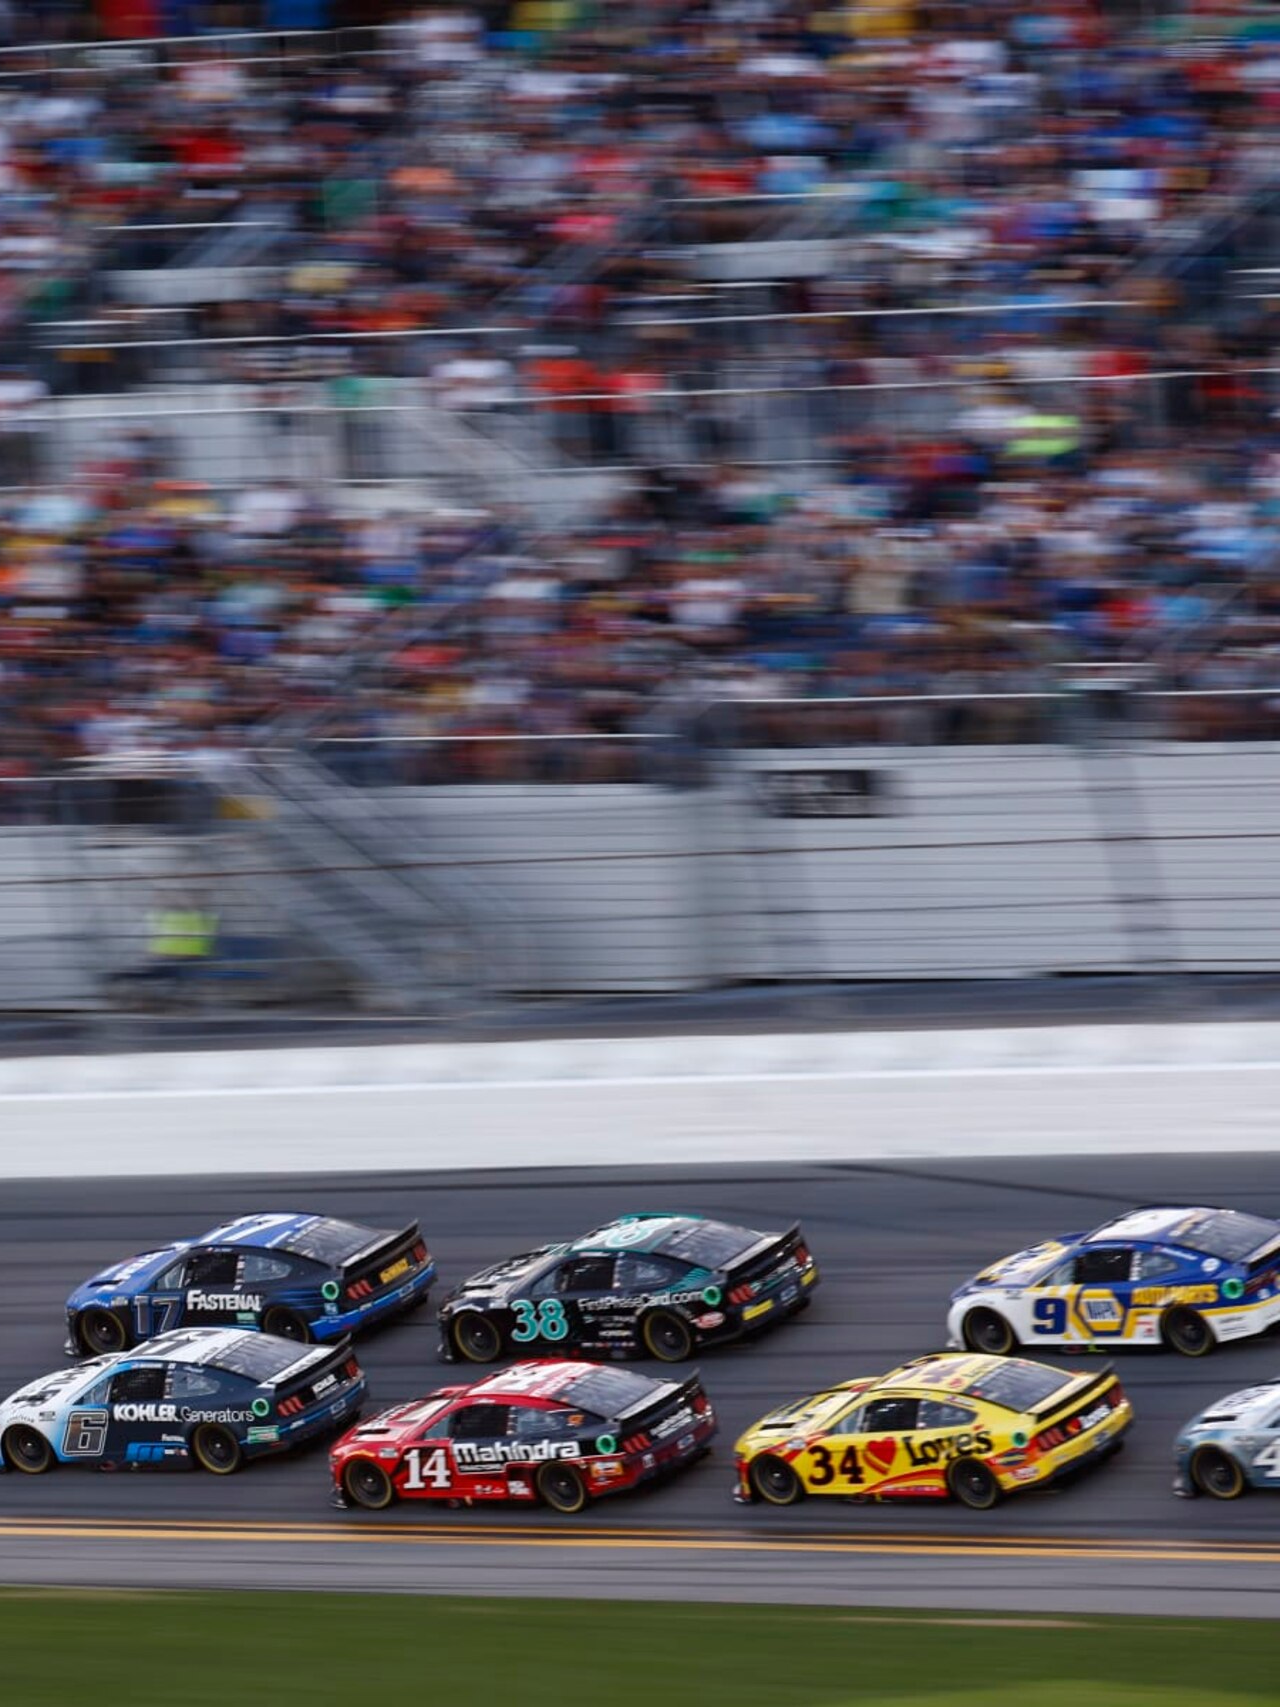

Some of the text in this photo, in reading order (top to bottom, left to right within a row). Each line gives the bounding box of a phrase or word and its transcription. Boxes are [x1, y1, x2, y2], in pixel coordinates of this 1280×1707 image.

[133, 1294, 182, 1334] 17
[186, 1289, 262, 1311] FASTENAL
[509, 1298, 568, 1342] 38
[1032, 1298, 1067, 1335] 9
[61, 1408, 108, 1457] 6
[114, 1404, 255, 1423] KOHLER Generators
[403, 1448, 451, 1490] 14
[451, 1439, 581, 1463] Mahindra
[807, 1439, 862, 1481] 34
